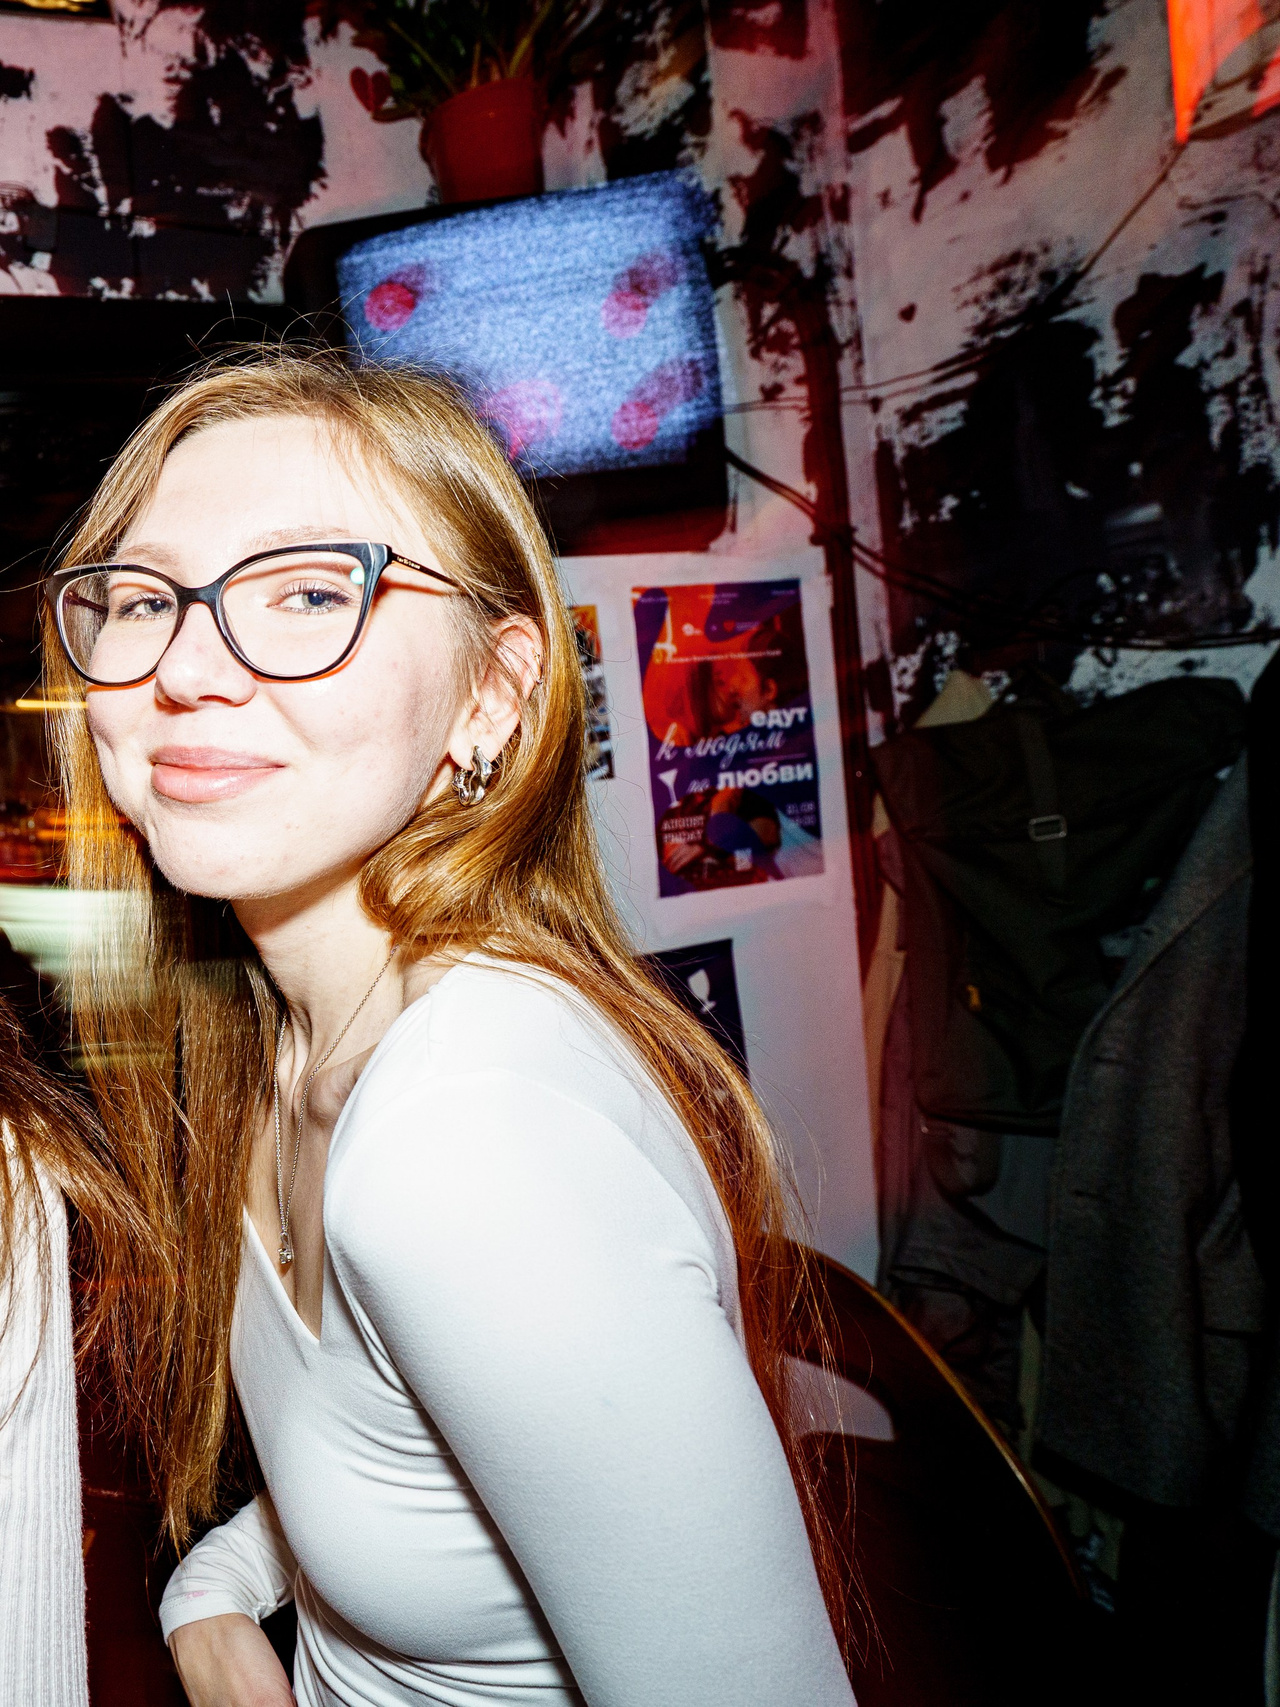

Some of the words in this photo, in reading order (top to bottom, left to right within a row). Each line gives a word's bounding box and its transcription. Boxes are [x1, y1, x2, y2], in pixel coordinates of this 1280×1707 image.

[750, 707, 808, 729] едут
[683, 731, 786, 770] людям
[716, 761, 814, 790] любви
